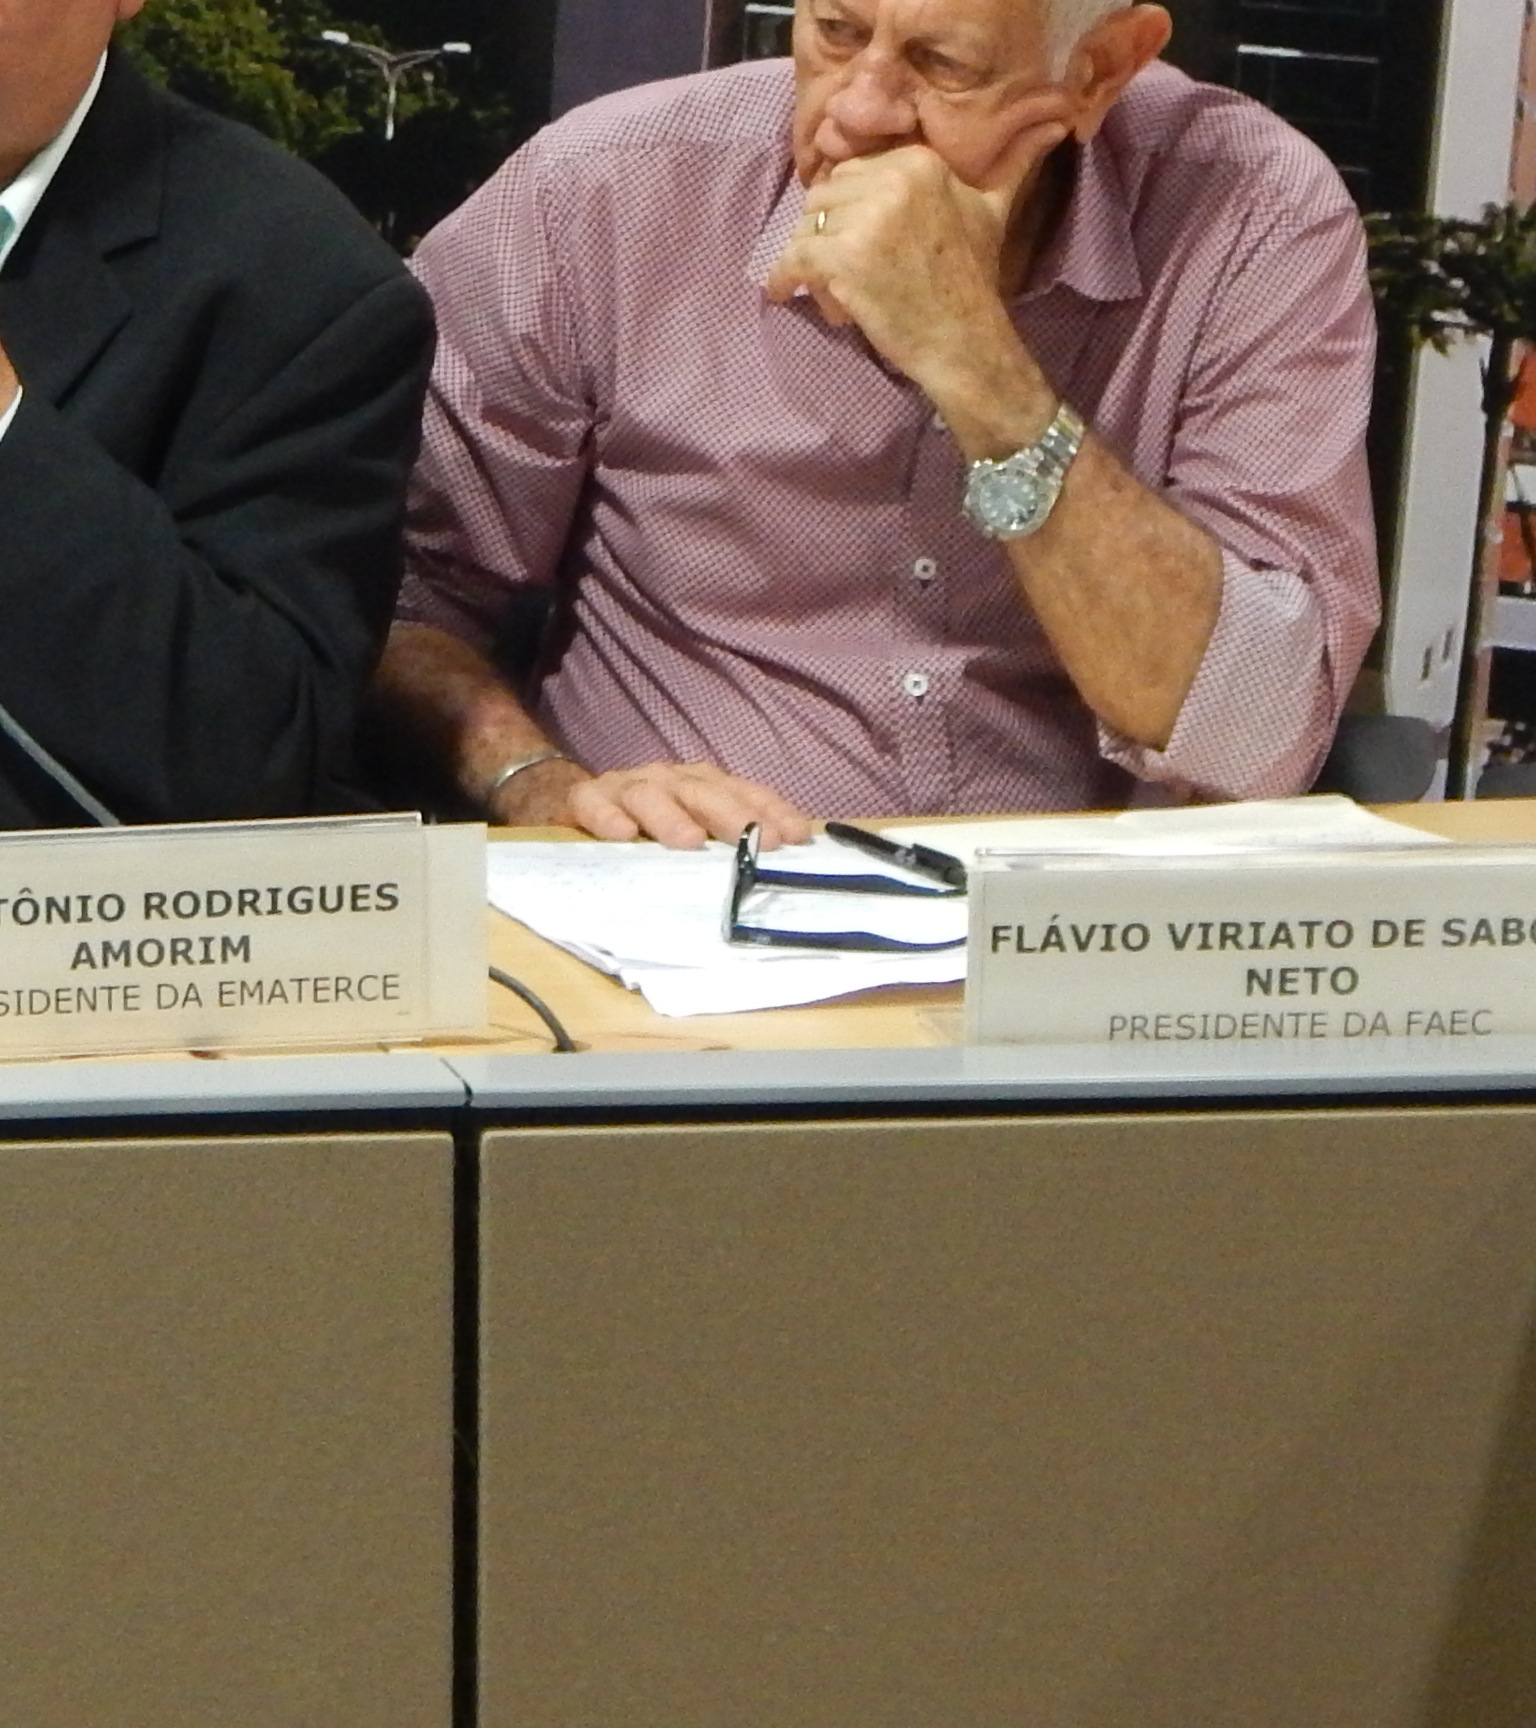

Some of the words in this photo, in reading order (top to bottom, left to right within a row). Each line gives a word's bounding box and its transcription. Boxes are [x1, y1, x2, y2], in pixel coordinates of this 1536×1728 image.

[143, 882, 399, 921] RODRIGUES
[70, 934, 252, 971] AMORIM
[990, 914, 1151, 954] FLÁVIO
[1167, 919, 1354, 951] VIRIATO
[1371, 918, 1426, 949] DE
[1441, 917, 1536, 948] SAB
[156, 981, 204, 1010] DA
[217, 973, 401, 1008] EMATERCE
[1246, 965, 1359, 997] NETO
[1108, 1011, 1328, 1042] PRESIDENTE
[1343, 1010, 1392, 1039] DA
[1404, 1008, 1494, 1037] FAEC
